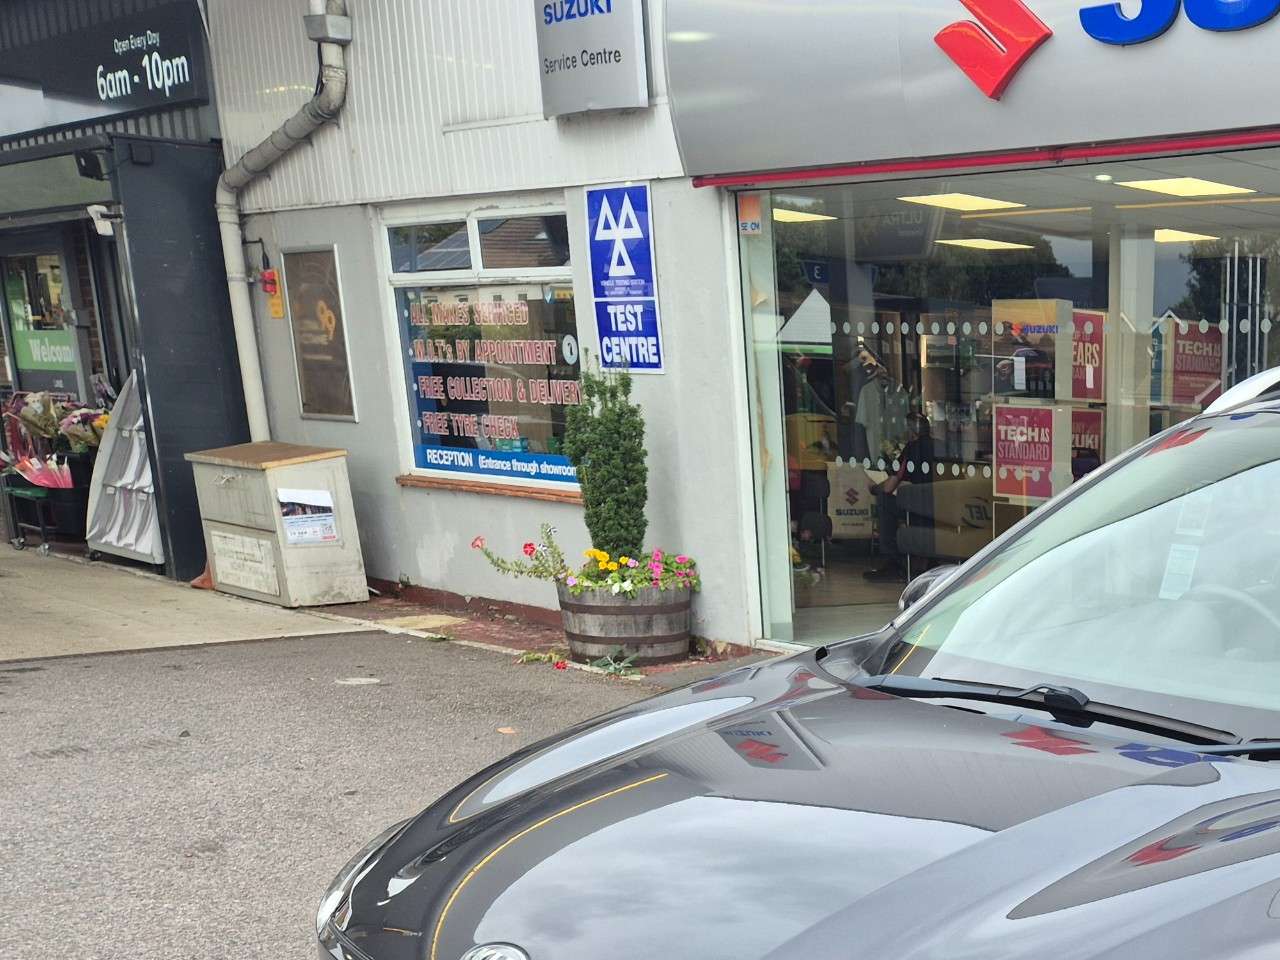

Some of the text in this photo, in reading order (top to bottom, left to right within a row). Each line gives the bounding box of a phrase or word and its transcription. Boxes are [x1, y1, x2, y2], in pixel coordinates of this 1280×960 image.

[543, 0, 613, 25] SUZUKI
[113, 29, 160, 55] Open Every Day
[543, 48, 622, 75] Service Centre
[96, 64, 132, 101] 6am
[142, 51, 190, 97] 10pm
[410, 303, 429, 326] ALL
[431, 302, 470, 326] MAKES
[607, 304, 645, 332] TEST
[1022, 324, 1059, 335] SUZUKI
[29, 337, 74, 362] Welcom
[456, 340, 471, 363] BY
[474, 340, 557, 365] APPOINTMENT
[601, 336, 659, 364] CENTRE
[1072, 342, 1100, 368] EARS
[1177, 340, 1213, 356] TECH
[418, 375, 446, 399] FREE
[447, 377, 513, 401] COLLECTION
[517, 379, 527, 403] &
[422, 411, 520, 440] FREE TYRE CHECK
[997, 425, 1050, 443] TECH AS
[426, 448, 474, 467] RECEPTION
[478, 454, 511, 471] (Entrance
[512, 460, 540, 476] through
[997, 441, 1050, 461] STANDARD
[835, 508, 869, 516] SUZUKI
